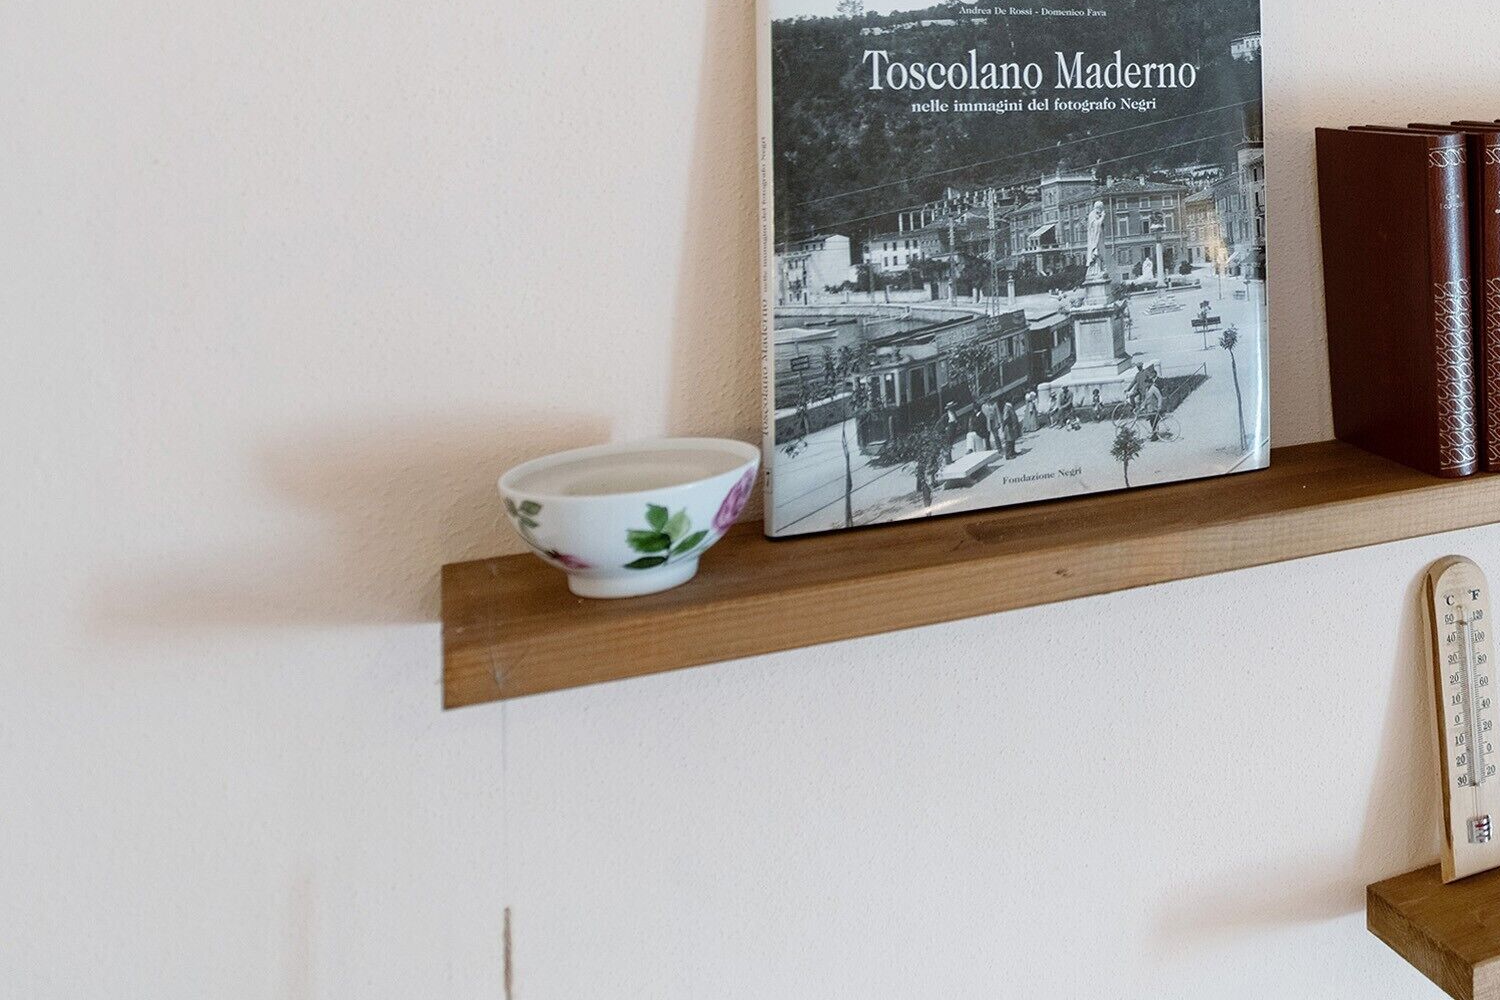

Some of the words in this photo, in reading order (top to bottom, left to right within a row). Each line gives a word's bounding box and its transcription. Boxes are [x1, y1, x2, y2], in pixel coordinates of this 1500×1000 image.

[958, 6, 992, 15] Andrea
[994, 6, 1007, 15] De
[1009, 7, 1033, 16] Rossi
[1041, 7, 1085, 17] Domenico
[1087, 8, 1107, 17] Fava
[862, 48, 1043, 91] Toscolano
[1054, 49, 1197, 90] Maderno
[911, 99, 949, 113] nelle
[953, 99, 1023, 115] immagini
[1027, 98, 1050, 112] del
[1054, 97, 1116, 113] fotografo
[1120, 97, 1157, 113] Negri
[1002, 472, 1055, 484] Fondazione
[1058, 467, 1082, 477] Negri
[1446, 632, 1456, 643] 40
[1474, 630, 1485, 642] 100
[1448, 653, 1458, 664] 30
[1477, 653, 1487, 664] 80
[1449, 672, 1459, 683] 20
[1479, 675, 1489, 686] 60
[1452, 693, 1461, 704] 10
[1481, 697, 1491, 708] 40
[1454, 714, 1460, 723] 0
[1482, 720, 1492, 731] 20
[1455, 734, 1464, 745] 10
[1486, 742, 1492, 752] 0
[1456, 754, 1466, 765] 20
[1486, 764, 1496, 775] 20
[1457, 774, 1467, 786] 30
